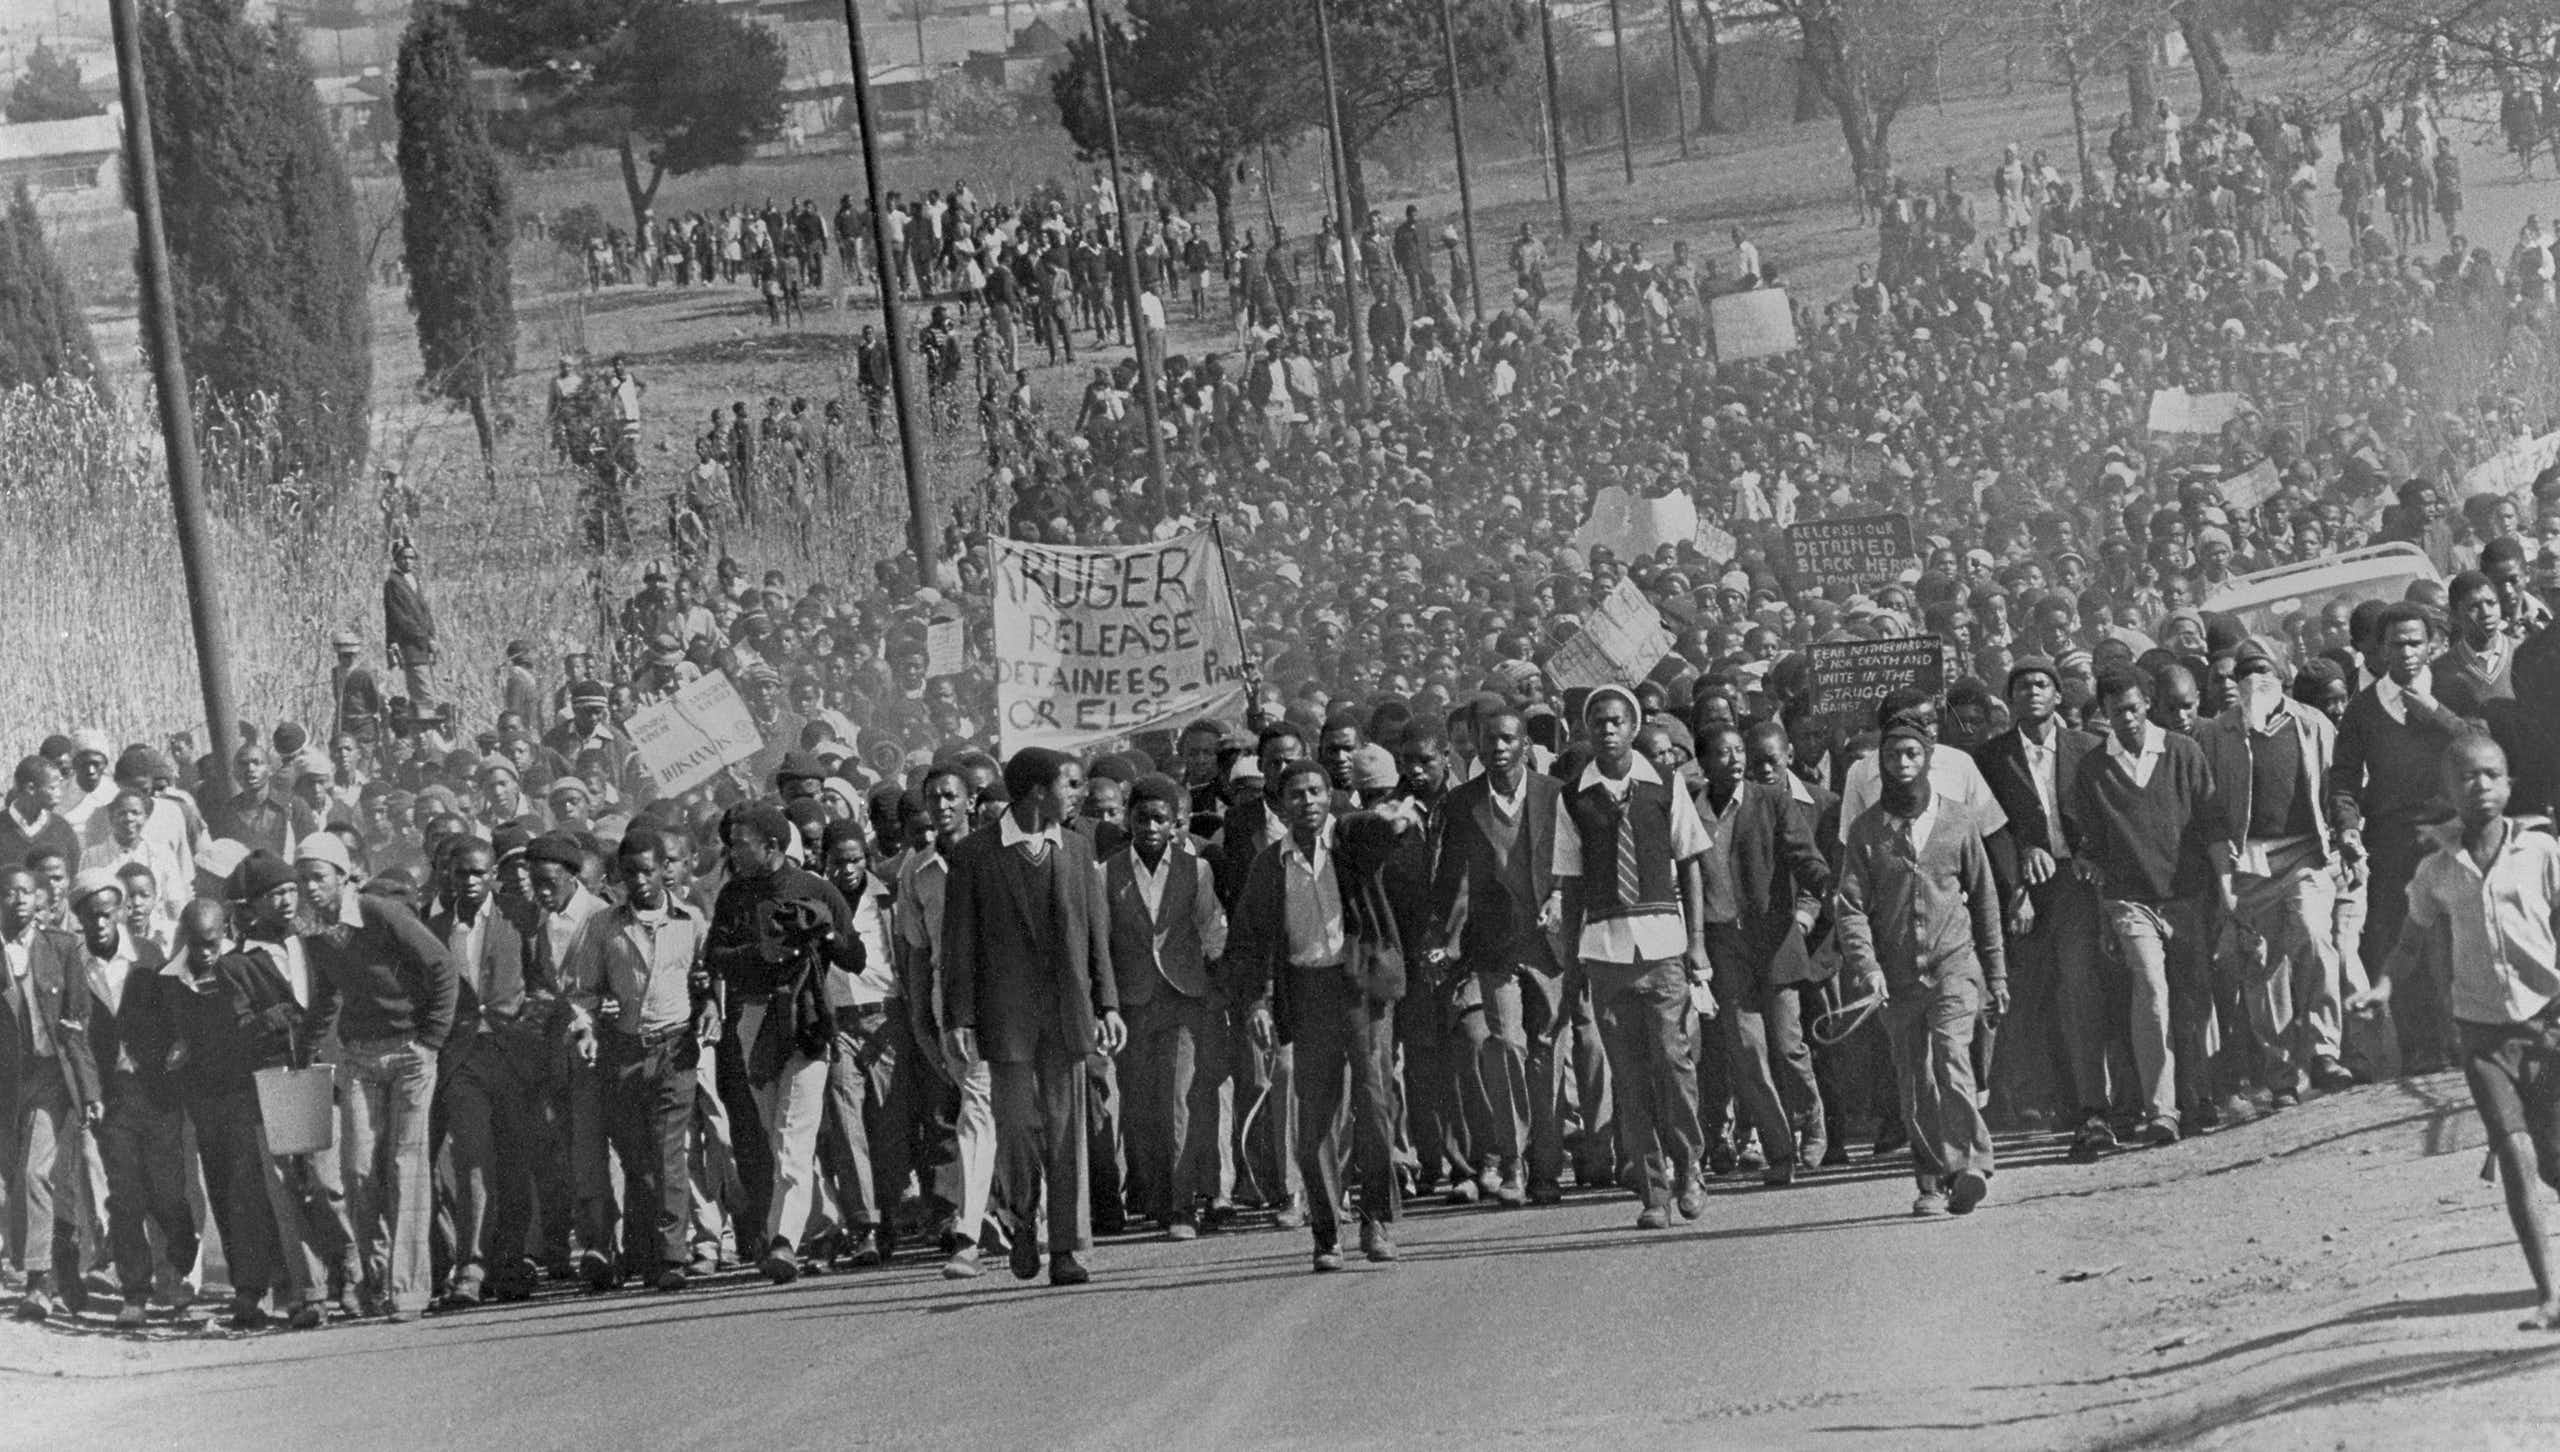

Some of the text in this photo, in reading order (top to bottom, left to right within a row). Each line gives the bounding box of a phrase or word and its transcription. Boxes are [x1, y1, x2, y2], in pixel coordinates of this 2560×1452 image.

[1864, 521, 1896, 536] OUR
[1793, 537, 1897, 558] DETAINED
[1796, 556, 1856, 573] BLACK
[1029, 610, 1200, 658] RELEASE
[1813, 647, 1846, 661] FEAR
[1830, 658, 1853, 671] NOR
[1858, 654, 1900, 667] DEATH
[1903, 653, 1933, 666] AND
[998, 659, 1171, 698] DETAINEES
[1818, 669, 1916, 685] UNITE IN THE
[1008, 699, 1062, 731] OR
[1812, 700, 1861, 715] AGAINST
